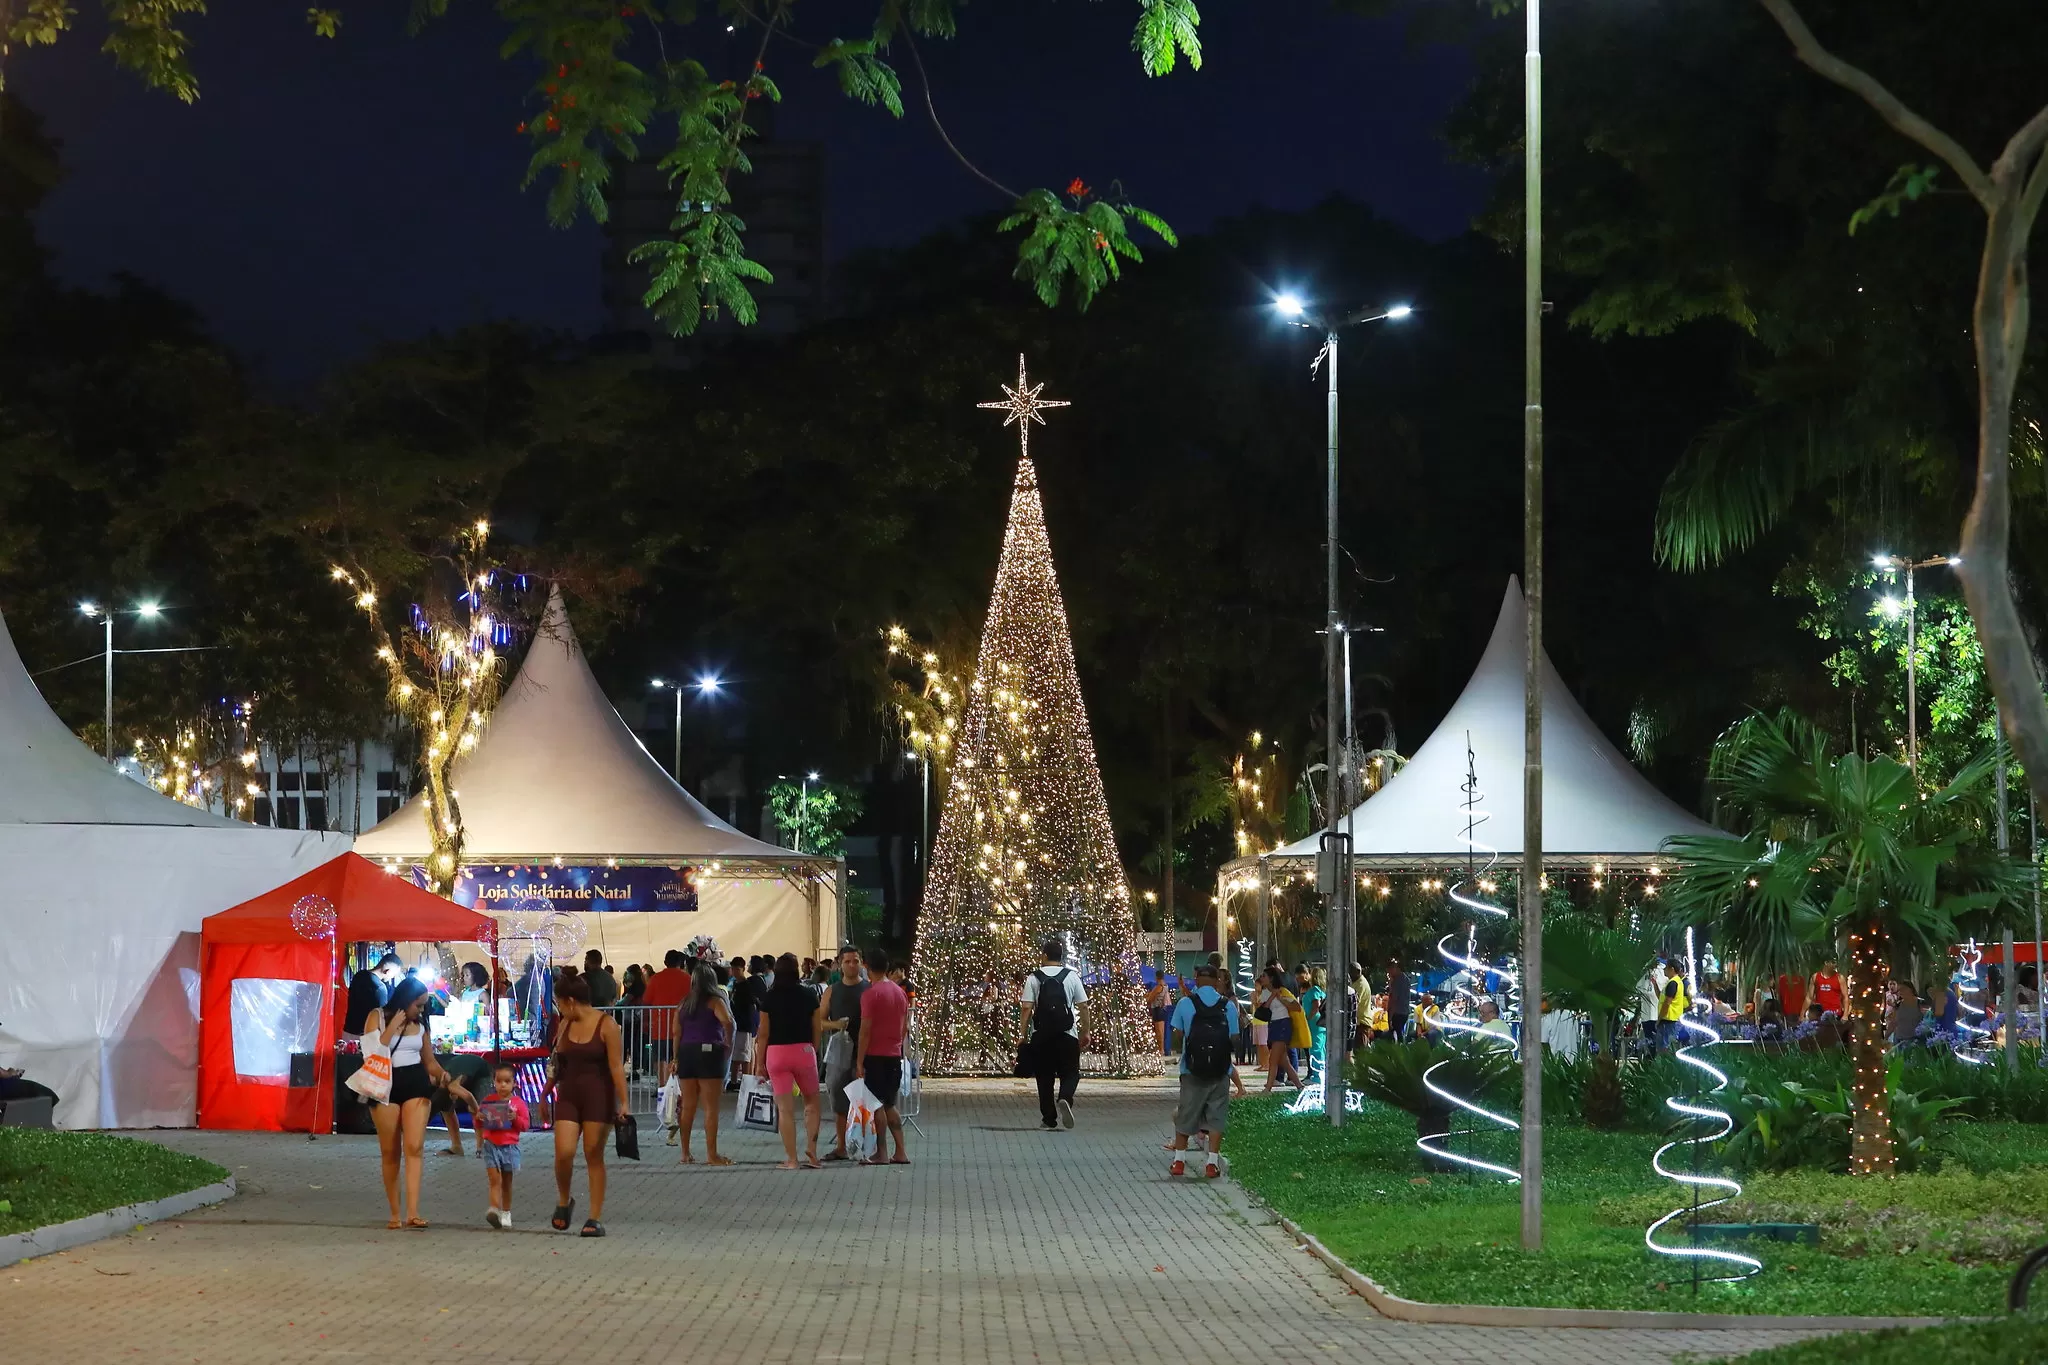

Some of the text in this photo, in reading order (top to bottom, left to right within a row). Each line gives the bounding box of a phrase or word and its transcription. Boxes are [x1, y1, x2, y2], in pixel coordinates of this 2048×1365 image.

[478, 883, 632, 902] Loja Solidária de Natal
